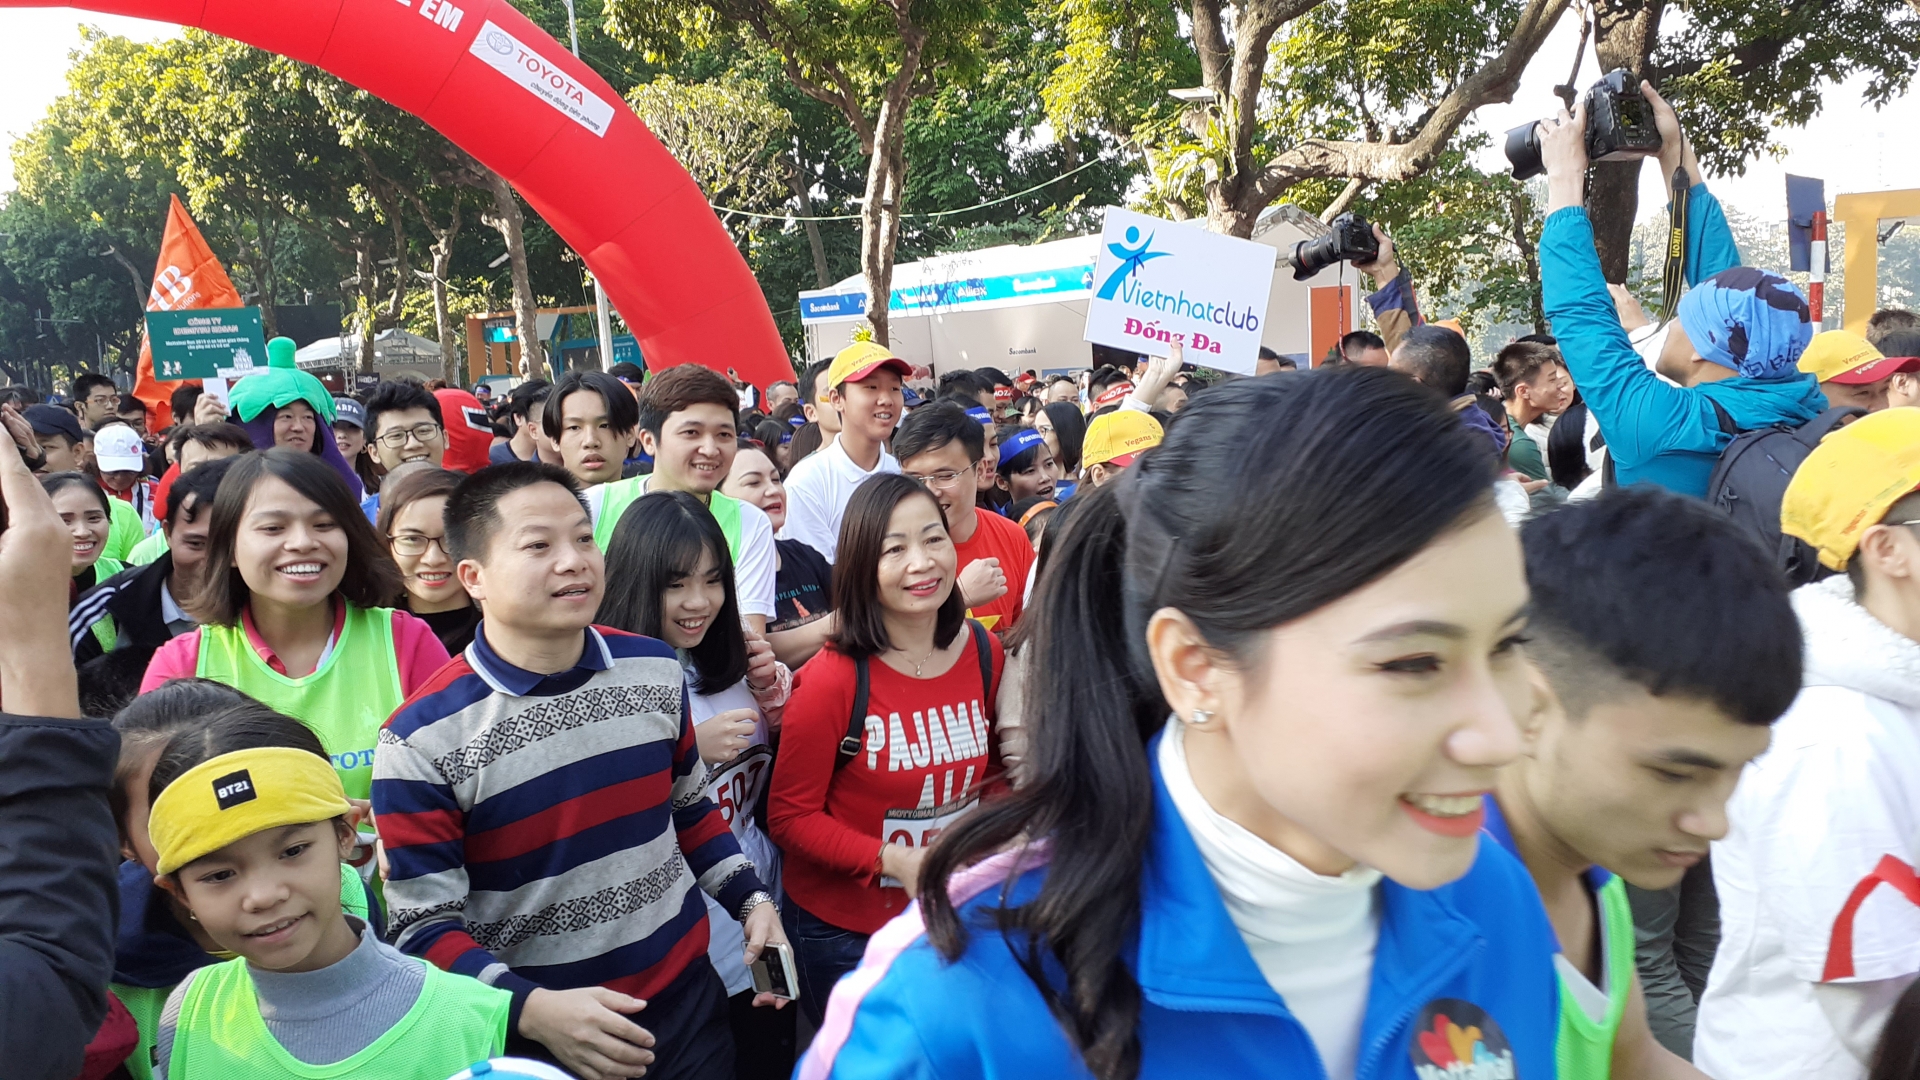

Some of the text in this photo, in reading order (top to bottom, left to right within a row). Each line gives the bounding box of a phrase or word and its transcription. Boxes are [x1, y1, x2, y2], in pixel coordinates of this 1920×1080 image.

[419, 0, 464, 32] EM
[516, 49, 585, 106] TOYOTA
[1081, 271, 1094, 285] A
[809, 299, 868, 313] Sacombank A
[1122, 276, 1259, 332] Vietnhatclub
[1009, 347, 1037, 355] Sacombank
[1123, 317, 1222, 354] Đống Đa
[1125, 434, 1152, 447] Vegans
[865, 699, 990, 771] PAJAMA
[218, 780, 250, 798] BT21
[717, 760, 767, 828] 507
